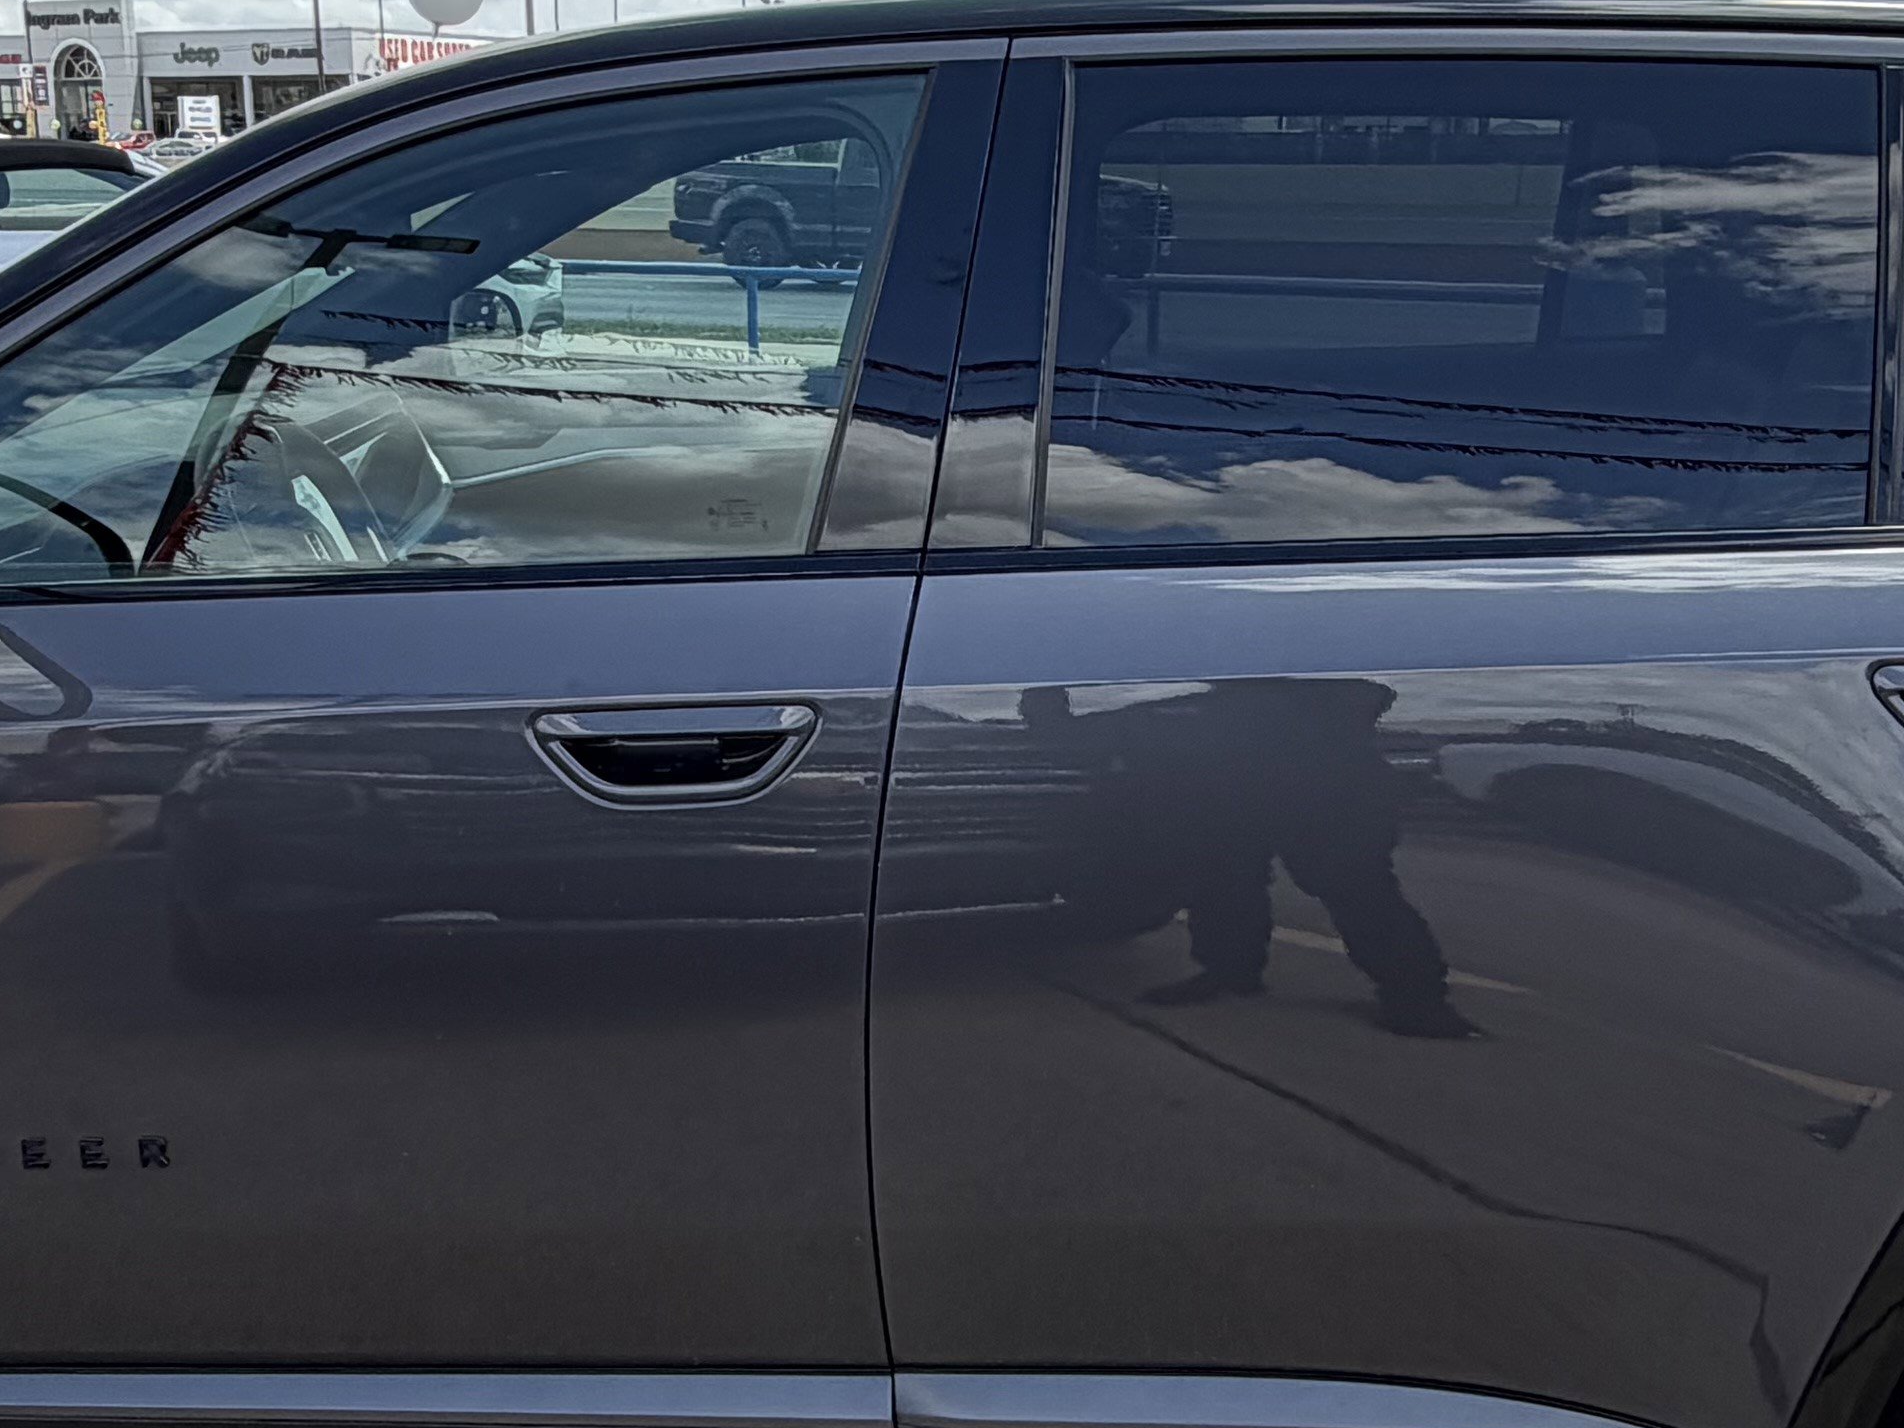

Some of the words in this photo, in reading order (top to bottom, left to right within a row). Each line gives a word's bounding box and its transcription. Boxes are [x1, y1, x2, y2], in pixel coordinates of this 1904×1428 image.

[83, 8, 121, 24] Park
[173, 42, 220, 67] Jeep
[379, 38, 407, 63] USED
